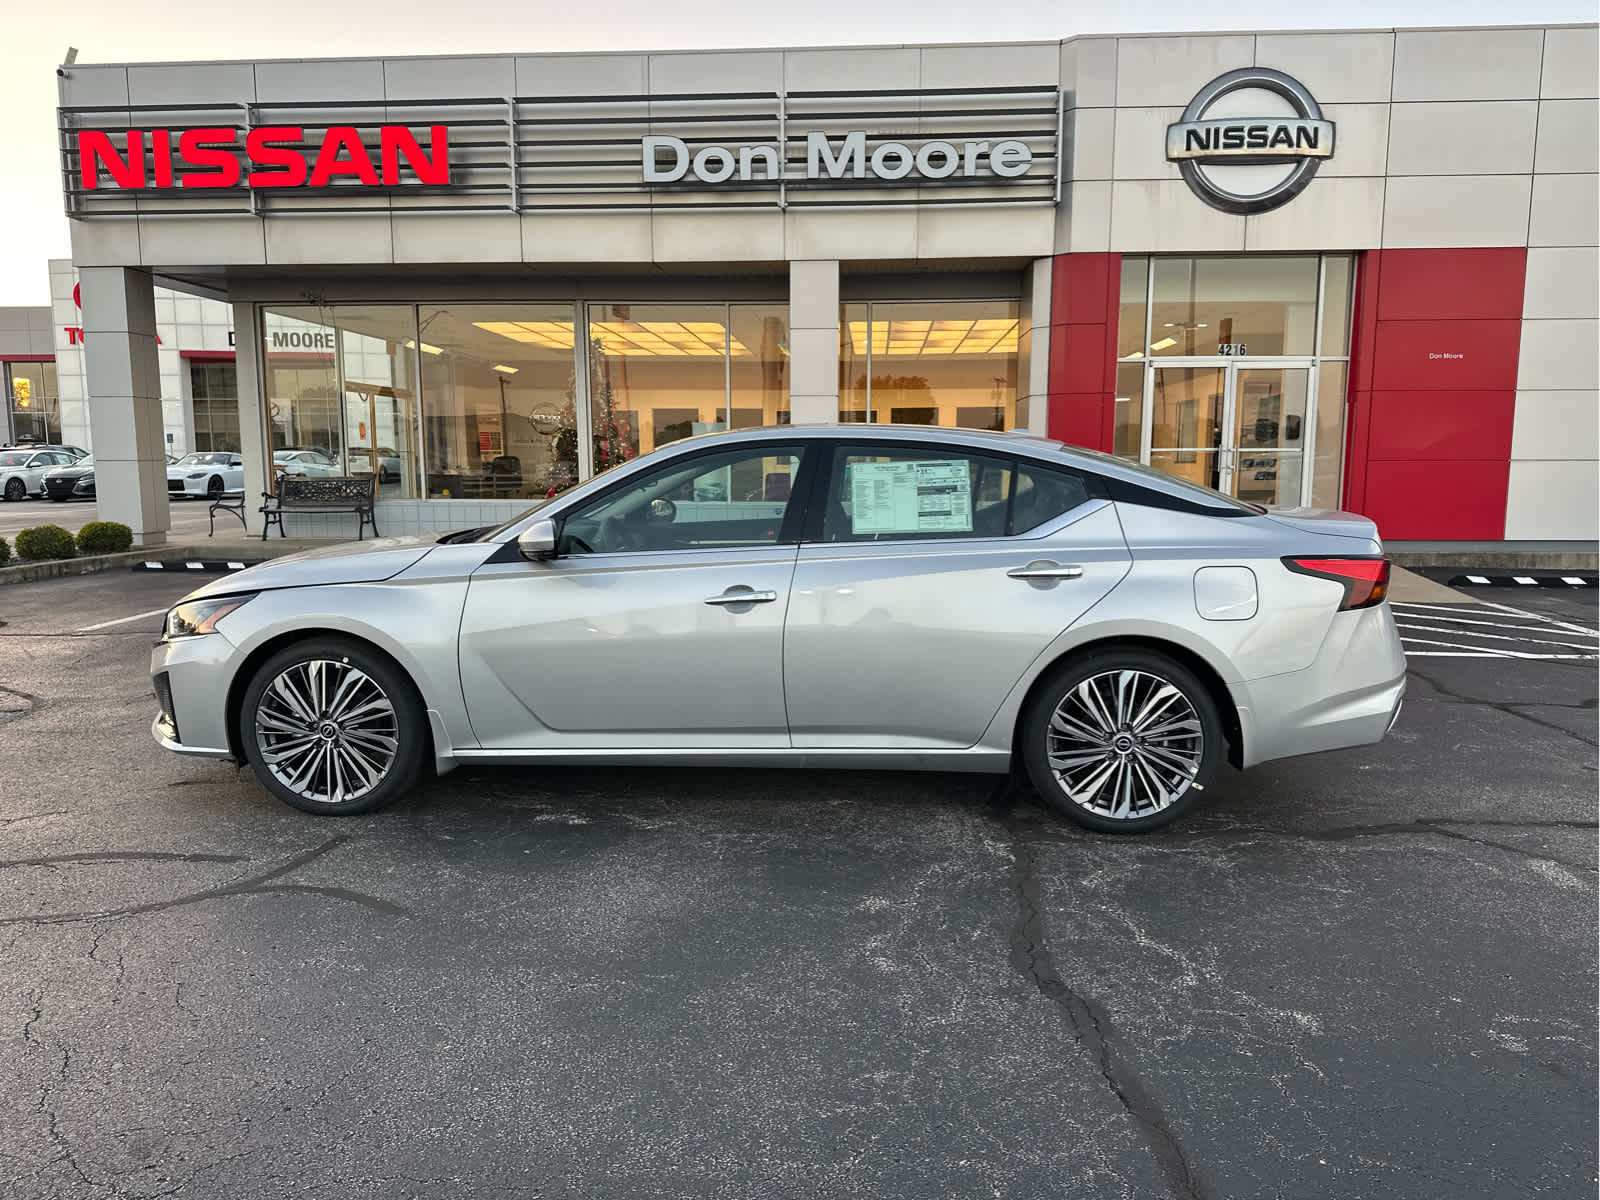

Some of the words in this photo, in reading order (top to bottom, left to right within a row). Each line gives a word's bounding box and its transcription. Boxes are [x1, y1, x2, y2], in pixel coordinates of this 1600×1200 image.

[1185, 125, 1319, 152] NISSAN
[78, 125, 450, 189] NISSAN
[641, 135, 779, 184] Don
[806, 131, 1033, 181] Moore
[272, 331, 335, 349] MOORE
[1218, 344, 1246, 356] 4216
[1429, 352, 1443, 360] Don
[1443, 352, 1464, 360] Moore
